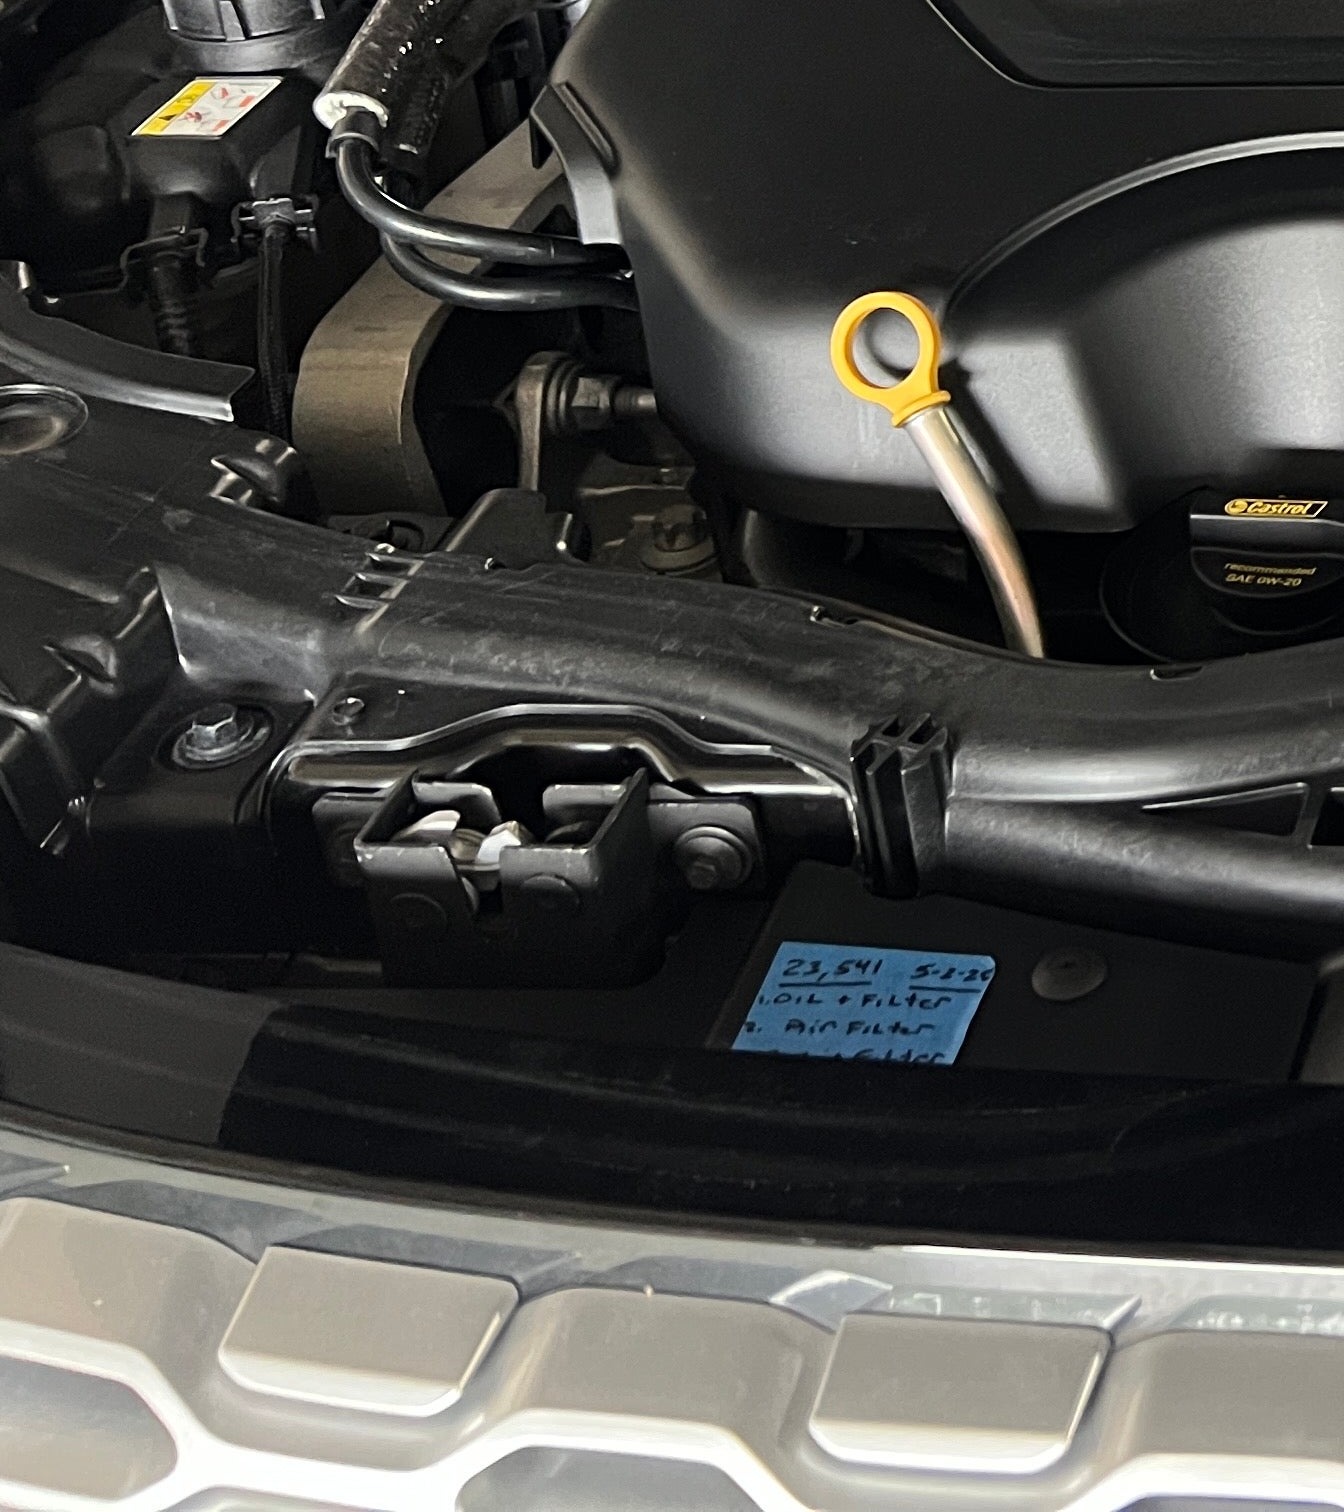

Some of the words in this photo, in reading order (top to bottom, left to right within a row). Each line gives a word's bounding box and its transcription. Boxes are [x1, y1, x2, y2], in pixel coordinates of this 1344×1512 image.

[1246, 500, 1313, 515] Castrol
[1225, 573, 1256, 584] SAE
[1256, 575, 1303, 587] 0W-20
[782, 958, 884, 982] 23,541
